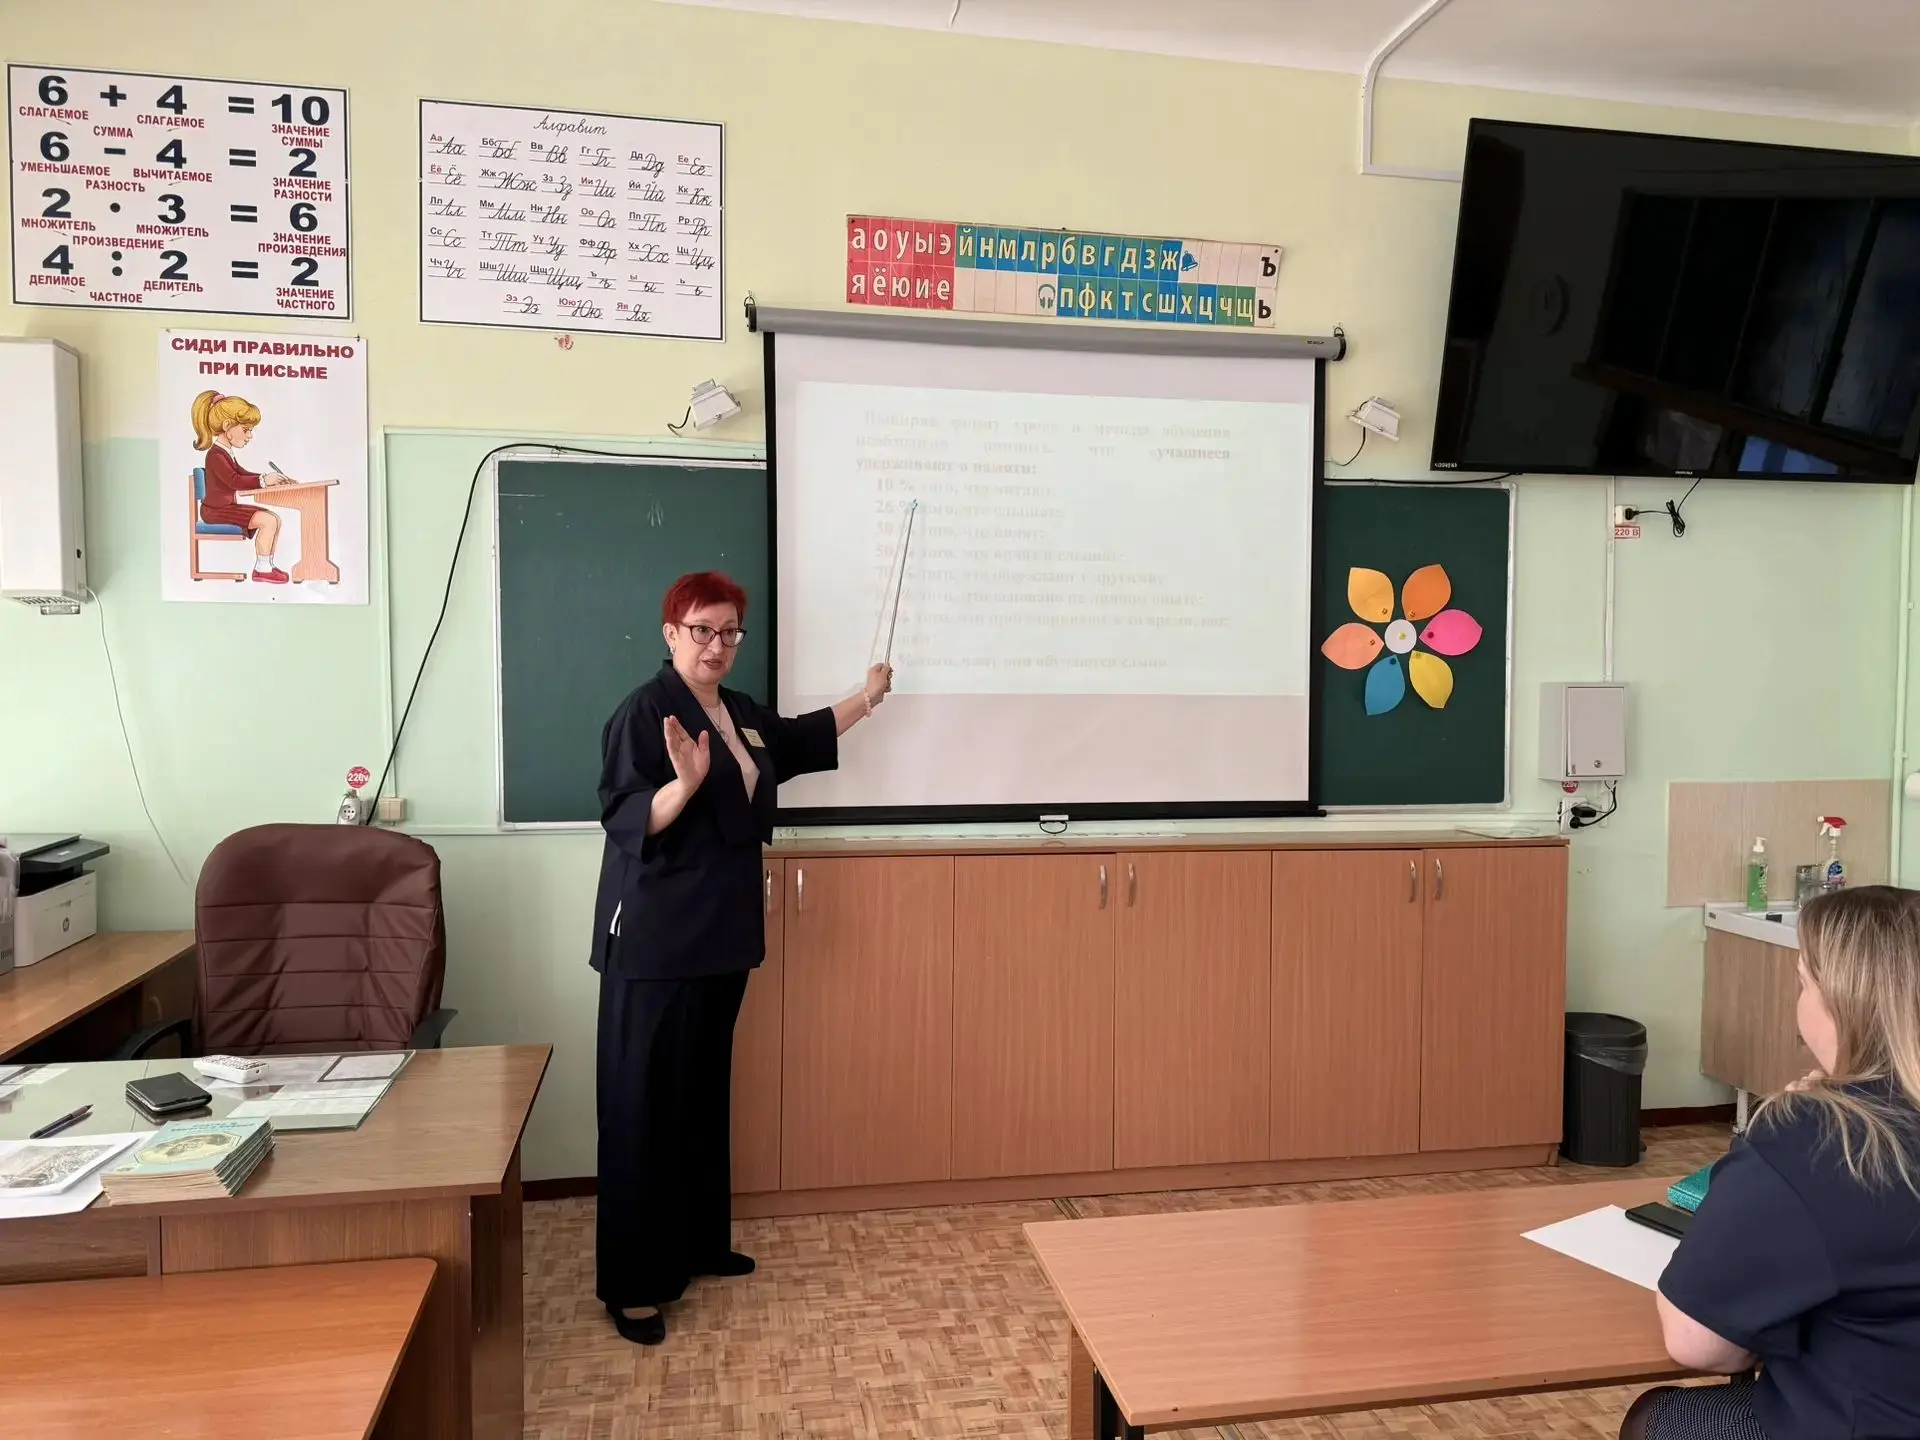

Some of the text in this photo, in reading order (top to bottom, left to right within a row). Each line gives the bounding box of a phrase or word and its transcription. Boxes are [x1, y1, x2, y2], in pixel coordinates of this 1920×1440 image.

[38, 75, 69, 106] 6
[156, 85, 187, 115] 4
[271, 94, 330, 125] 10
[19, 106, 89, 120] СЛАГАЕМОЕ
[137, 114, 205, 128] СЛАГАЕМОЕ
[533, 115, 607, 136] Алфавит
[93, 126, 133, 138] СУММА
[271, 124, 330, 137] ЗНАЧЕНИЕ
[281, 135, 323, 148] СУММЫ
[40, 132, 69, 162] 6
[156, 139, 187, 168] 4
[289, 148, 317, 178] 2
[21, 162, 110, 177] УМЕНЬШАЕМОЕ
[133, 168, 213, 182] ВЫЧИТАЕМОЕ
[85, 180, 145, 192] РАЗНОСТЬ
[272, 178, 331, 190] ЗНАЧЕНИЕ
[274, 189, 332, 202] РАЗНОСТИ
[41, 188, 71, 218] 2
[157, 194, 186, 224] 3
[289, 203, 318, 232] 6
[21, 218, 96, 231] МНОЖИТЕЛЬ
[136, 224, 209, 238] МНОЖИТЕЛЬ
[72, 236, 164, 250] ПРОИЗВЕДЕНИЕ
[273, 233, 331, 245] ЗНАЧЕНИЕ
[258, 243, 346, 257] ПРОИЗВЕДЕНИЯ
[42, 245, 74, 275] 4
[159, 250, 188, 280] 2
[290, 257, 319, 287] 2
[29, 274, 85, 287] ДЕЛИМОЕ
[143, 281, 203, 293] ДЕЛИТЕЛЬ
[90, 292, 143, 303] ЧАСТНОЕ
[276, 287, 334, 299] ЗНАЧЕНИЕ
[277, 299, 335, 311] ЧАСТНОГО
[171, 338, 354, 358] СИДИ ПРАВИЛЬНО
[200, 362, 328, 379] ПРИ ПИСЬМЕ
